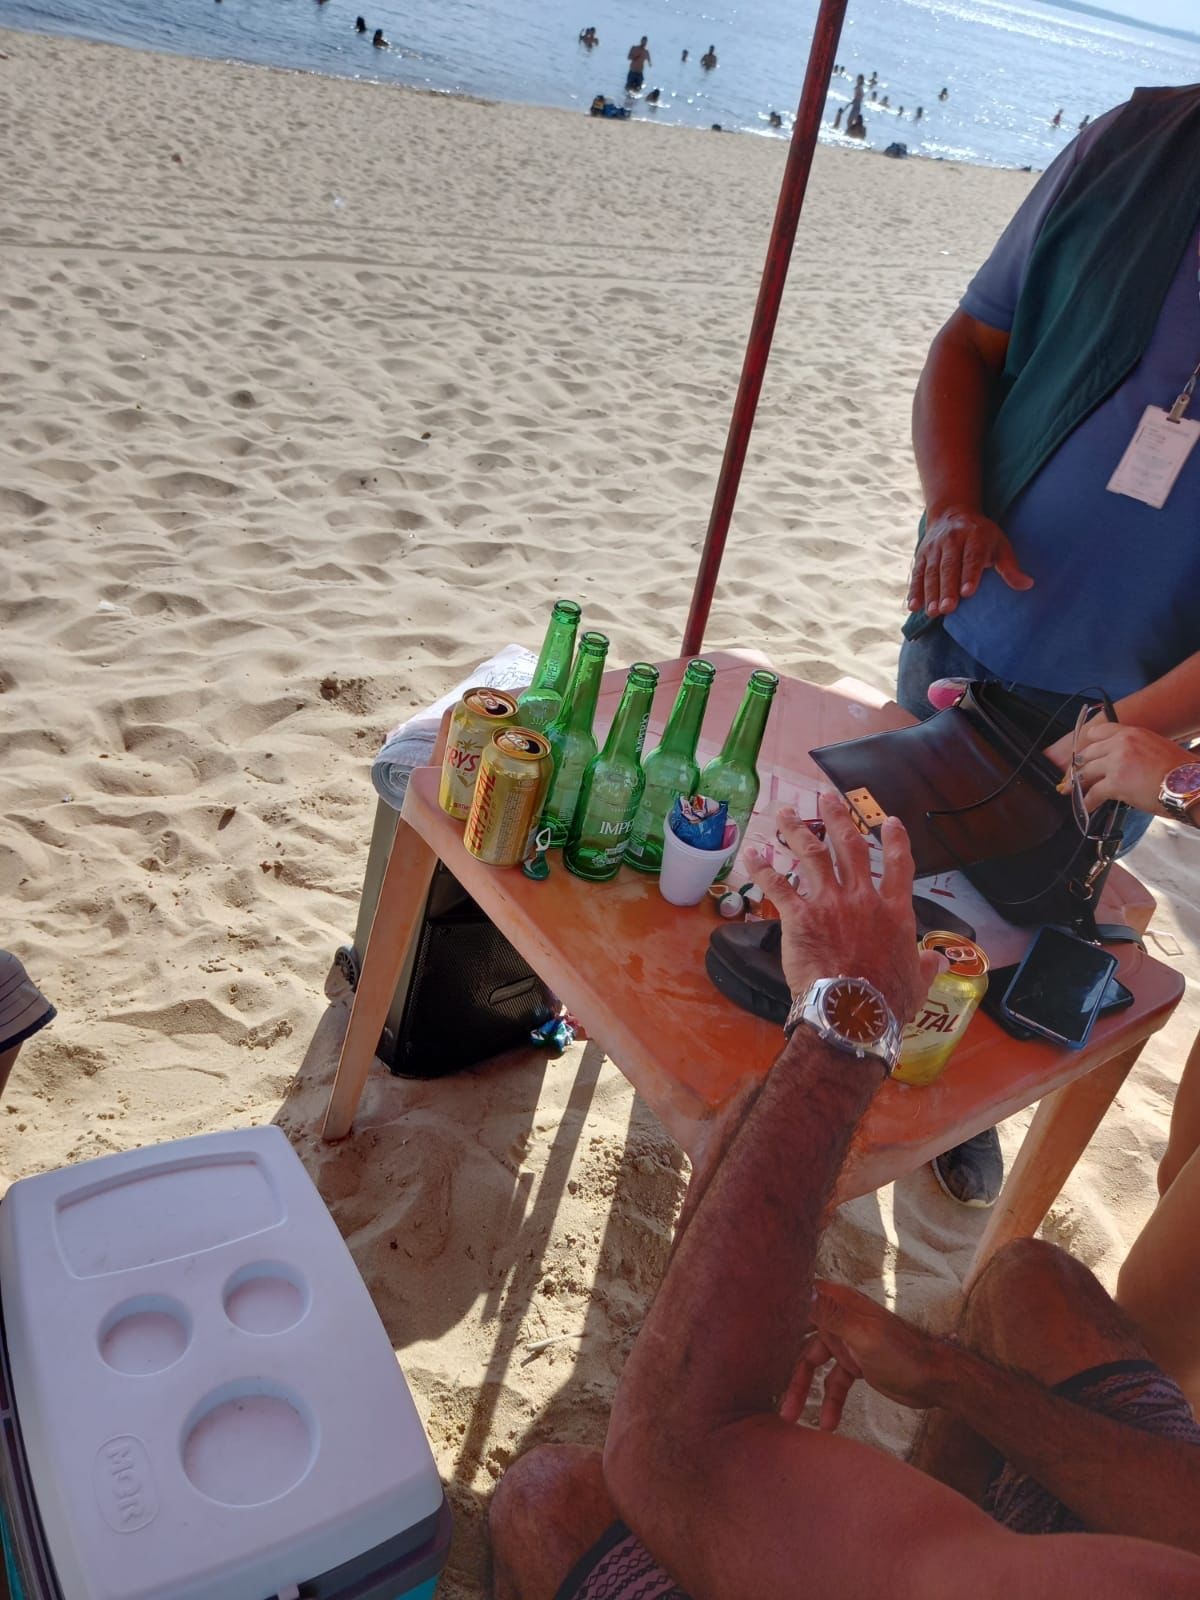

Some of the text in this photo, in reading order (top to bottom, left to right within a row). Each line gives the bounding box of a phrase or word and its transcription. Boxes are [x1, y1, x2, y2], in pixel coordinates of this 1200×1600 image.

[448, 748, 480, 773] RYS
[914, 1009, 961, 1033] TAL
[105, 1444, 145, 1523] MOR
